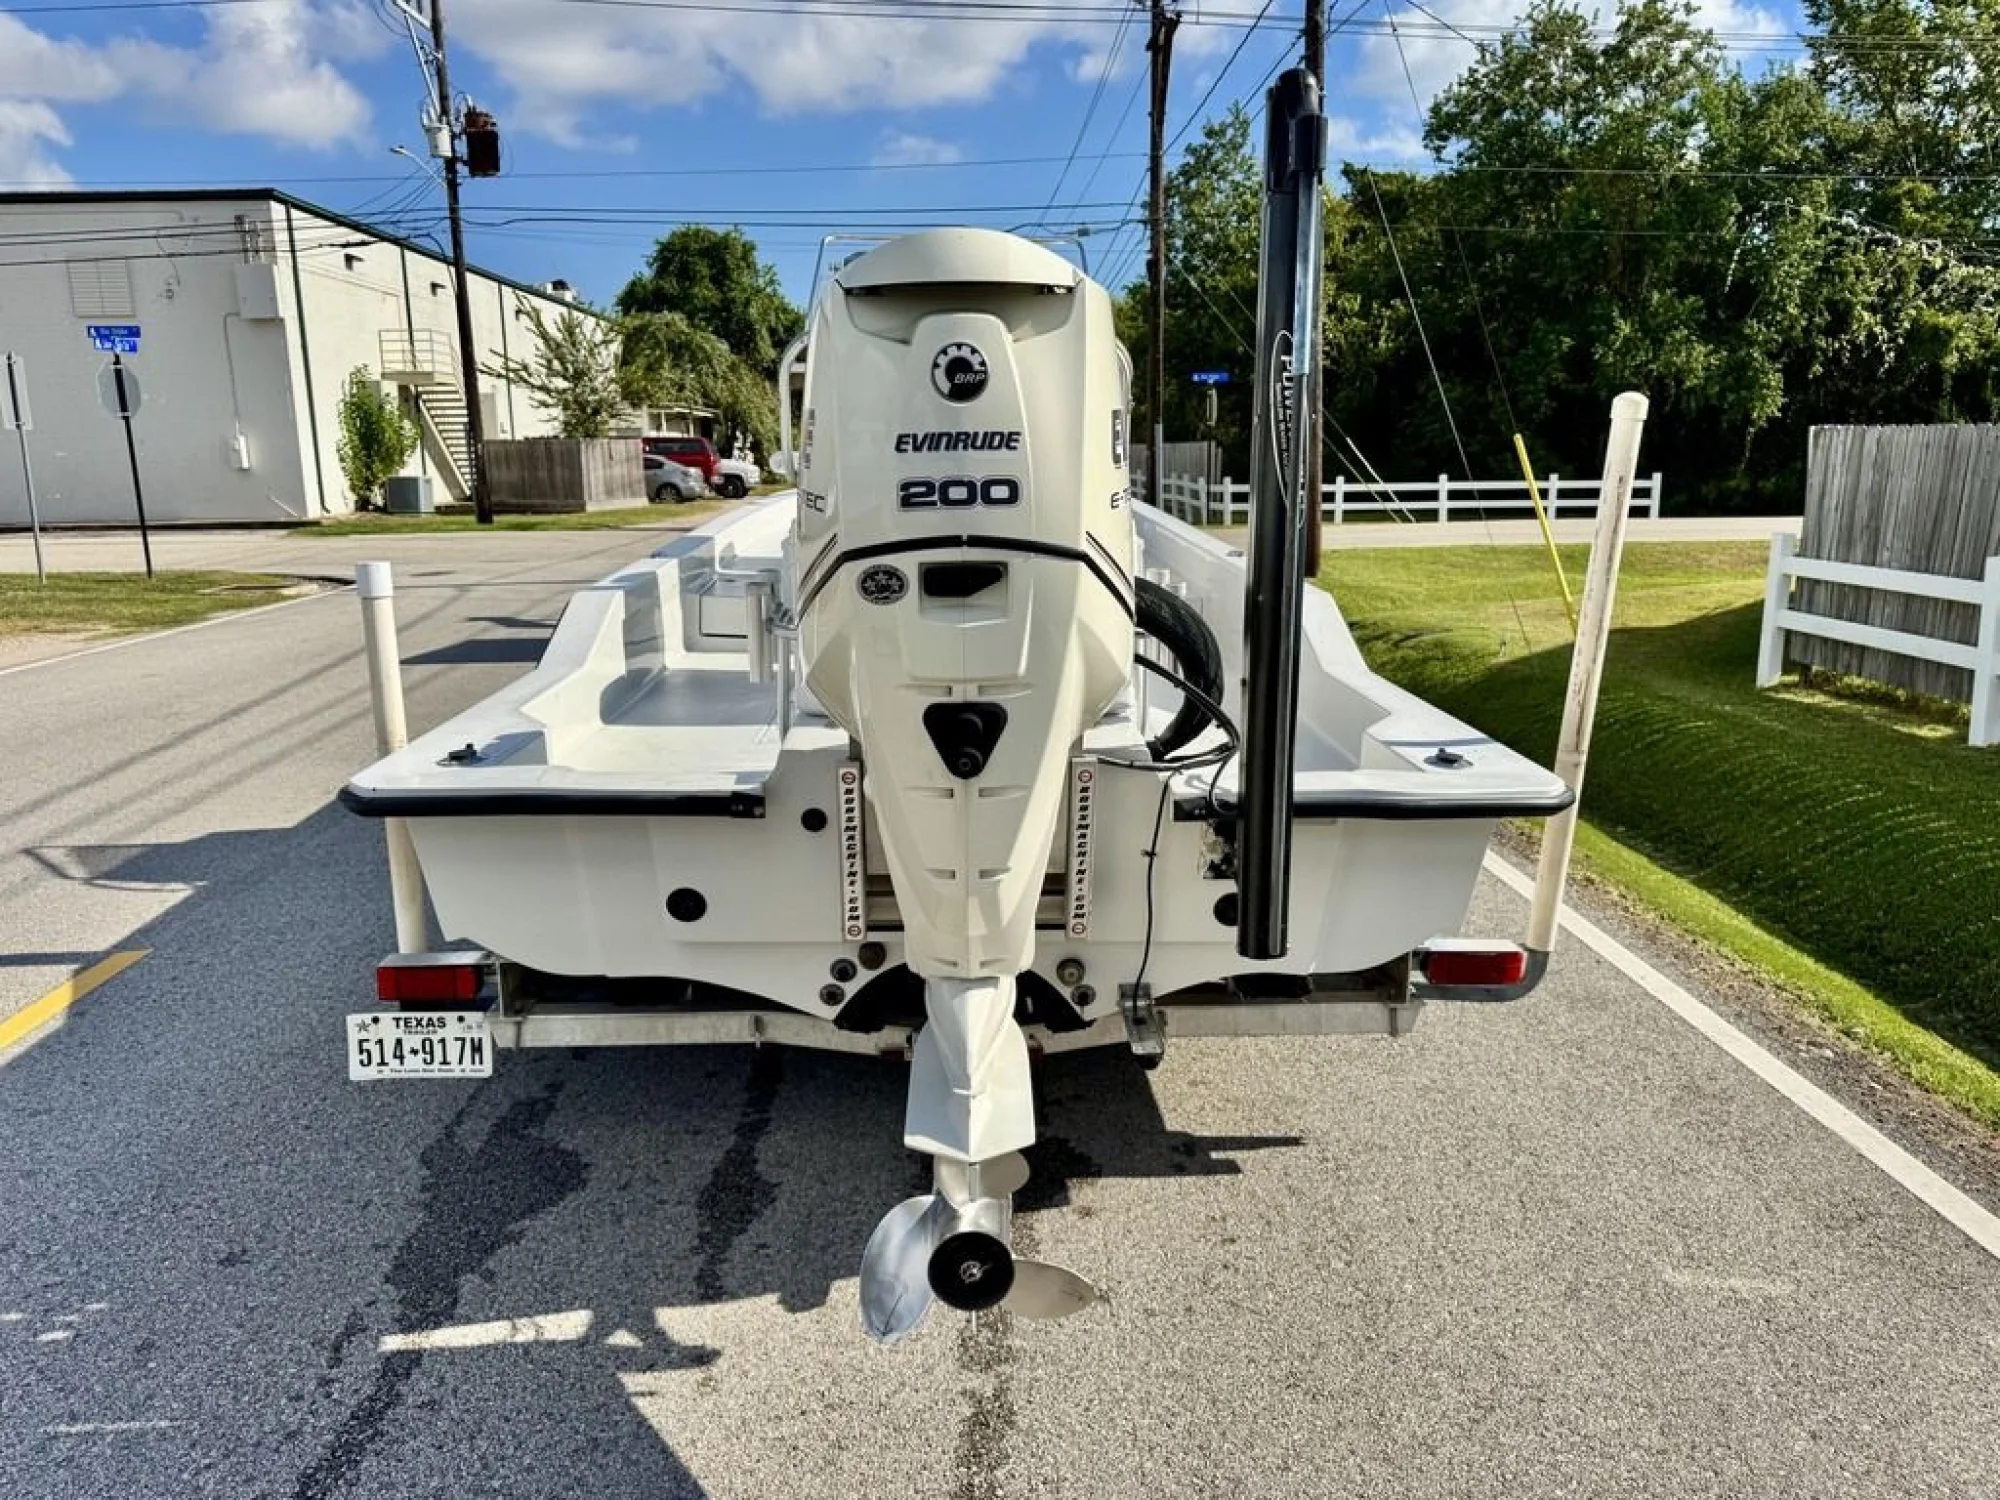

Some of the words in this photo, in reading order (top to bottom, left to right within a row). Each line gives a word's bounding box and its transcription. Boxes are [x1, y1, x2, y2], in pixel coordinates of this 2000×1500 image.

[953, 372, 985, 384] BRP
[894, 431, 1021, 453] EVINRUDE
[898, 477, 1020, 509] 200
[392, 1016, 446, 1029] TEXAS
